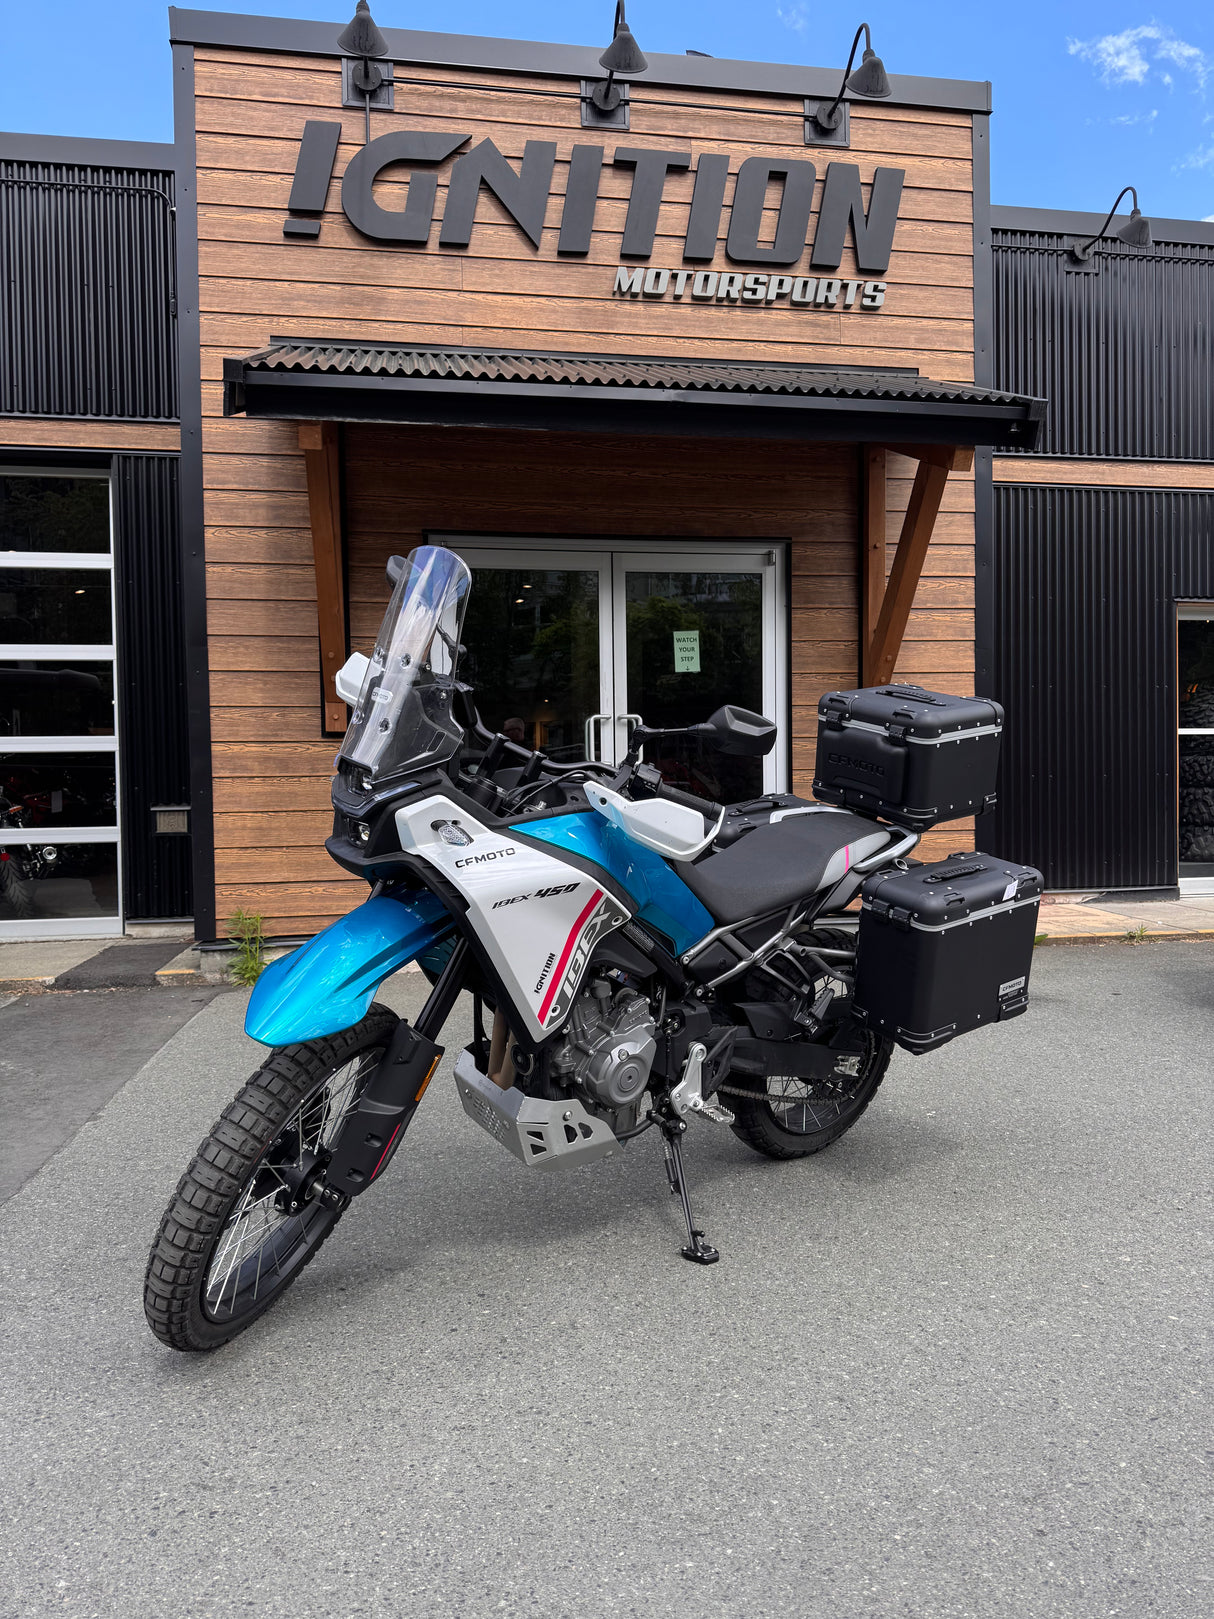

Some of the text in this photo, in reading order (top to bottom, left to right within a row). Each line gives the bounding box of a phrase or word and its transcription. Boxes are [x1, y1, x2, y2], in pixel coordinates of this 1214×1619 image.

[612, 265, 888, 310] MOTORSPORTS
[455, 847, 516, 869] CFMOTO
[491, 881, 581, 909] IBEX 450
[563, 902, 611, 999] IBEX
